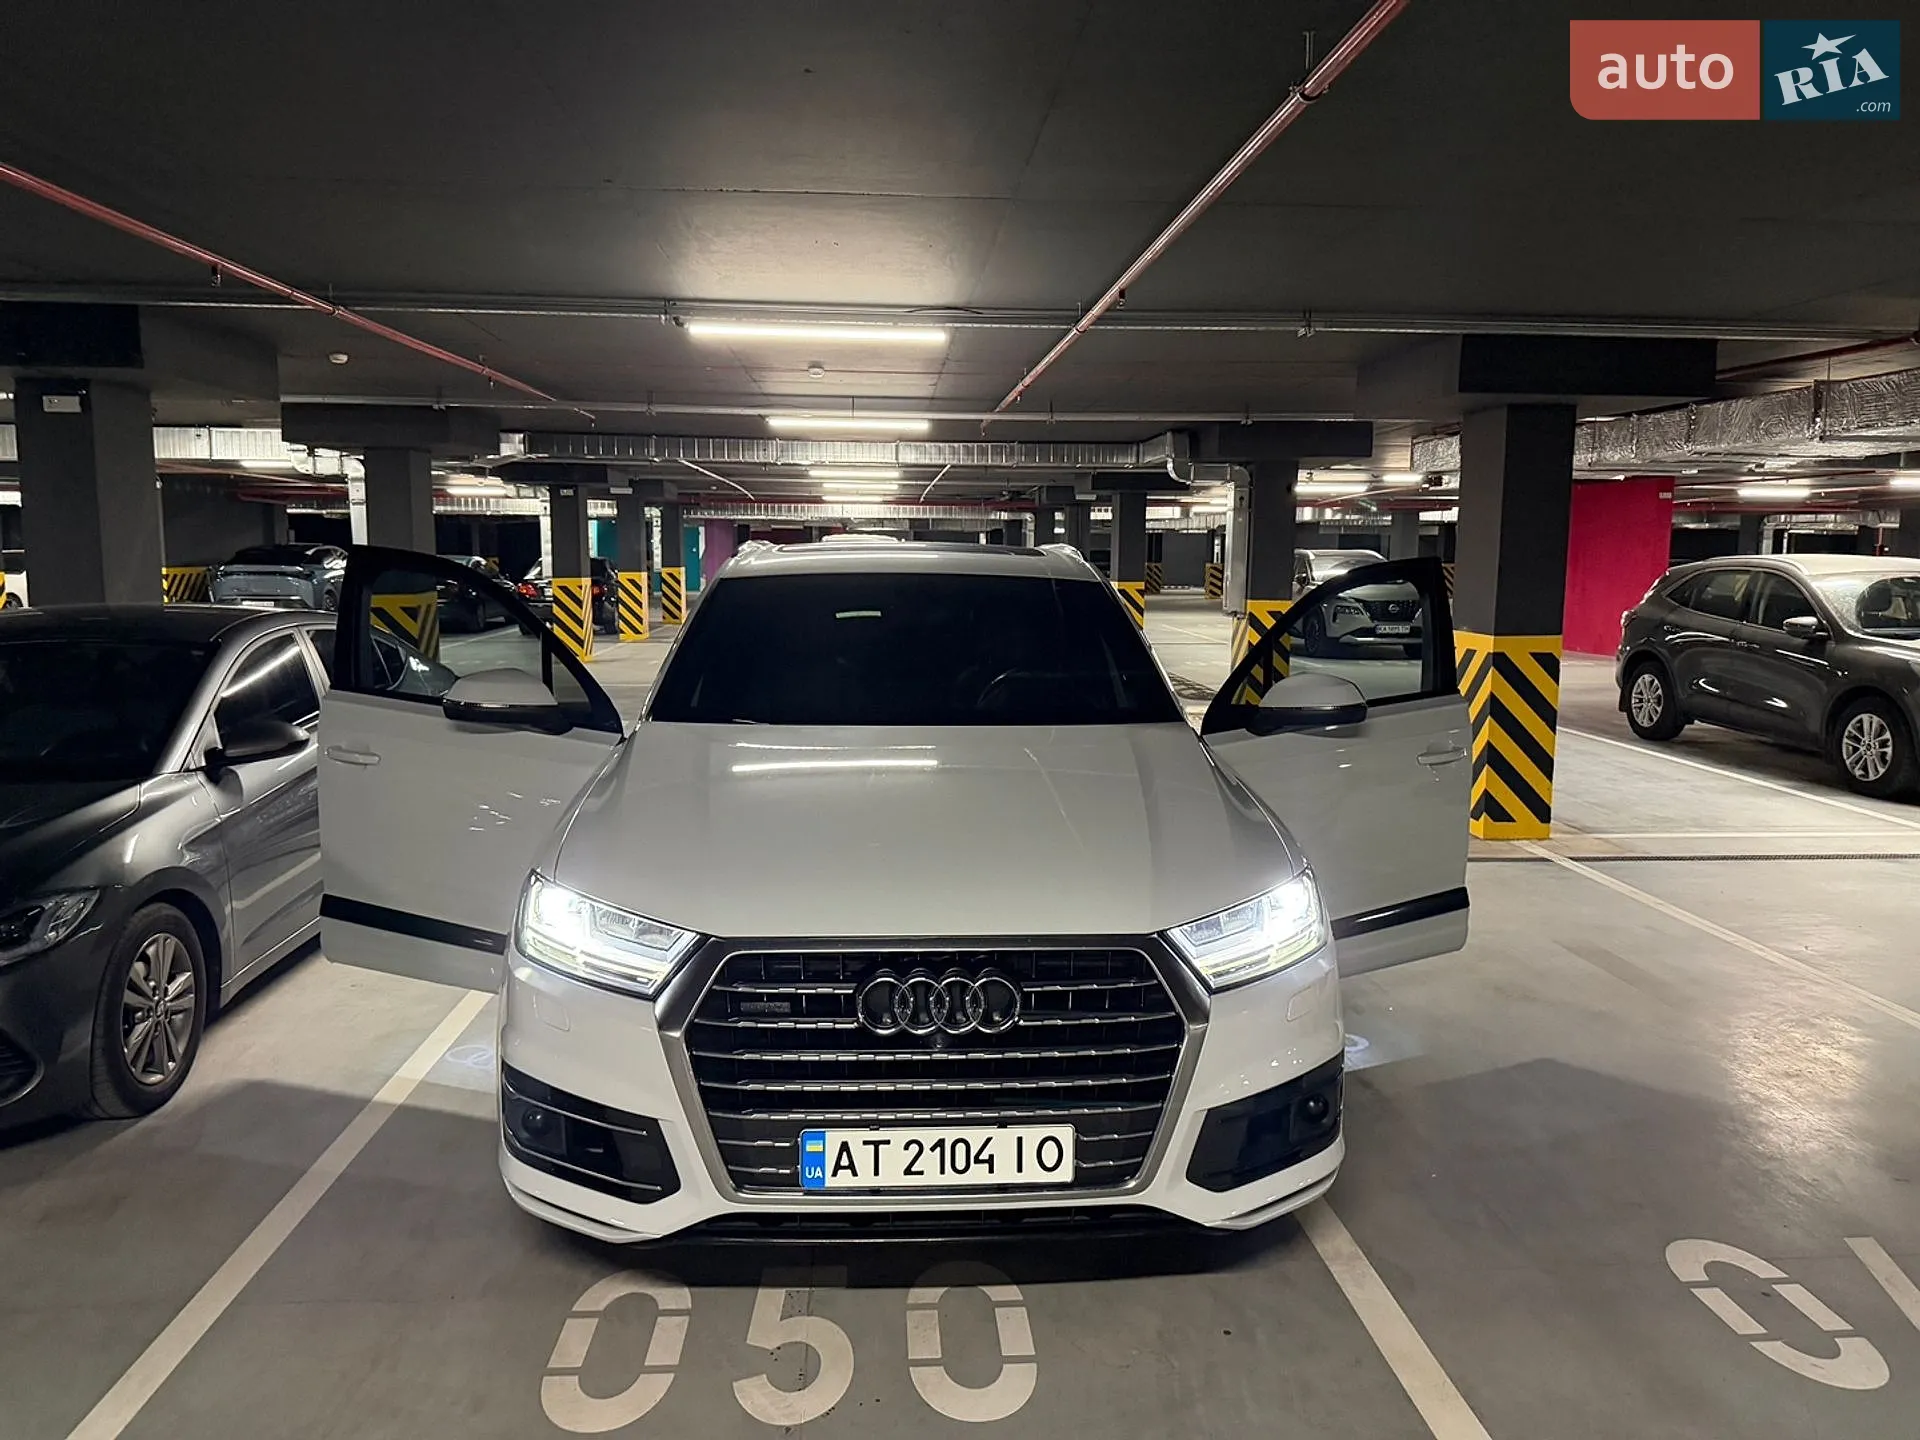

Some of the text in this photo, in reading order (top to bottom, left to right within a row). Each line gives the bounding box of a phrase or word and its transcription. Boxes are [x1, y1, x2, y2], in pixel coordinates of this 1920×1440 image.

[806, 1166, 823, 1179] UA
[831, 1135, 1064, 1178] AT 2104 IO
[541, 1260, 1038, 1433] 050
